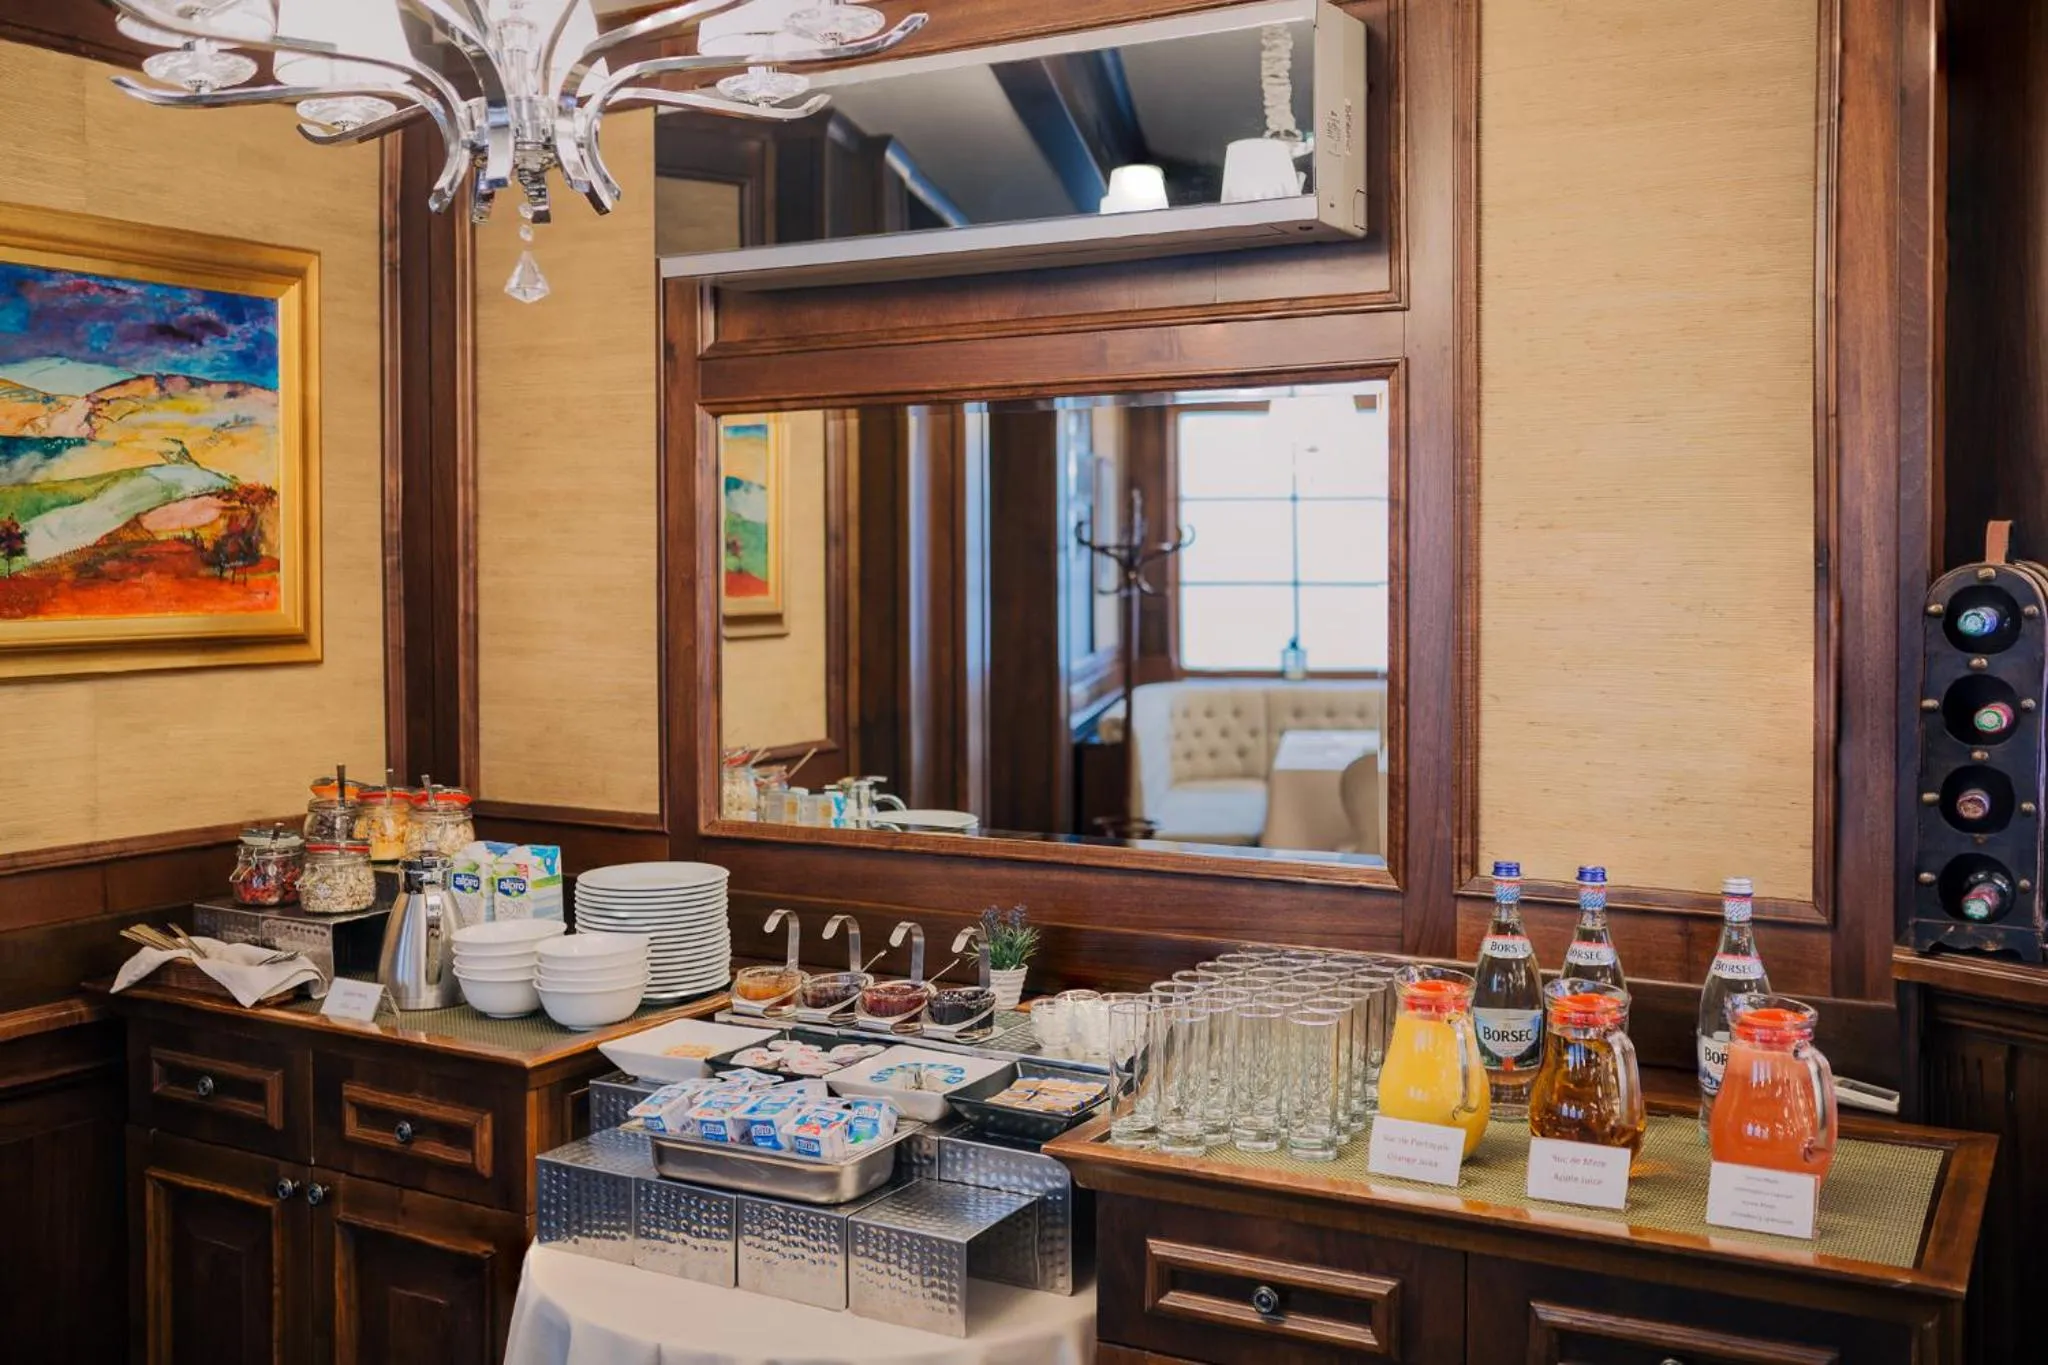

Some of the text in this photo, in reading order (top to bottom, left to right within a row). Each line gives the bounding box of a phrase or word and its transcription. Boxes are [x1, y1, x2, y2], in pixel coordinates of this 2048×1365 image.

[455, 874, 479, 889] alpro
[500, 878, 525, 892] alpro
[1490, 941, 1527, 953] BORSC
[1483, 1026, 1533, 1042] BORSEC
[1704, 1046, 1728, 1065] BOR
